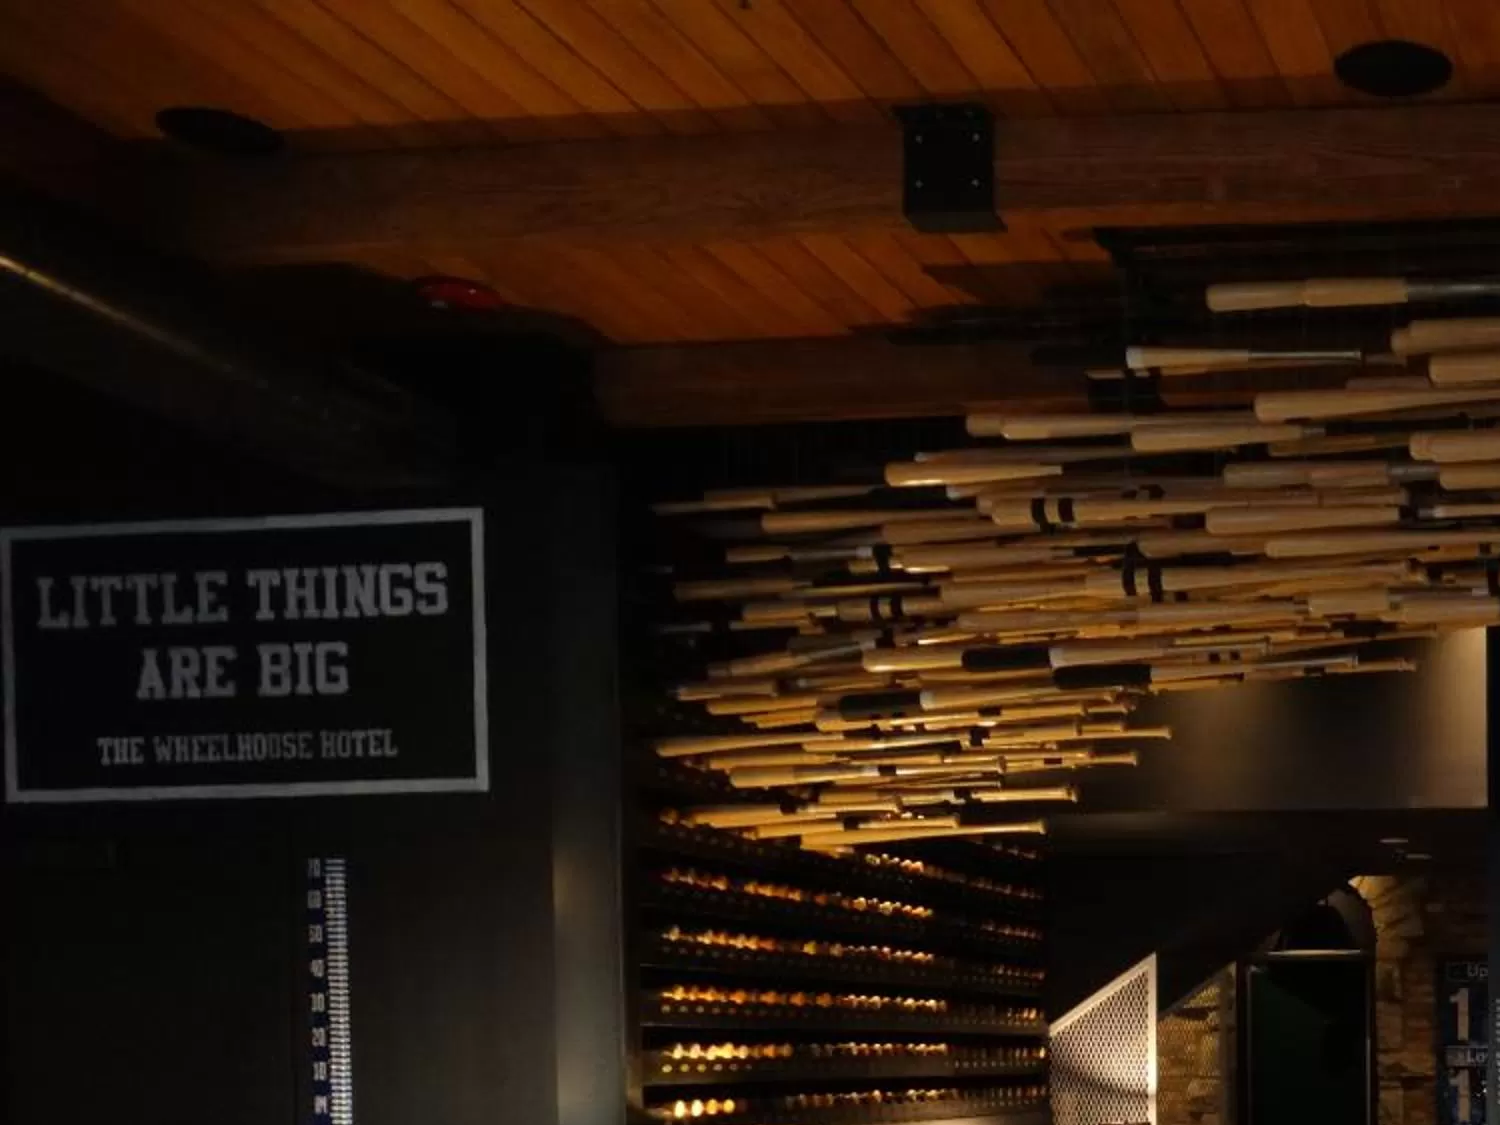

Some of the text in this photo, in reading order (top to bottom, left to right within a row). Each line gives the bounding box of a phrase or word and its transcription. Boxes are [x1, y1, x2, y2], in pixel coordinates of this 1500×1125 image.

[36, 561, 449, 630] LITTLE THINGS
[136, 640, 350, 701] ARE BIG
[97, 728, 398, 766] THE WHEELHOUSE HOTEL
